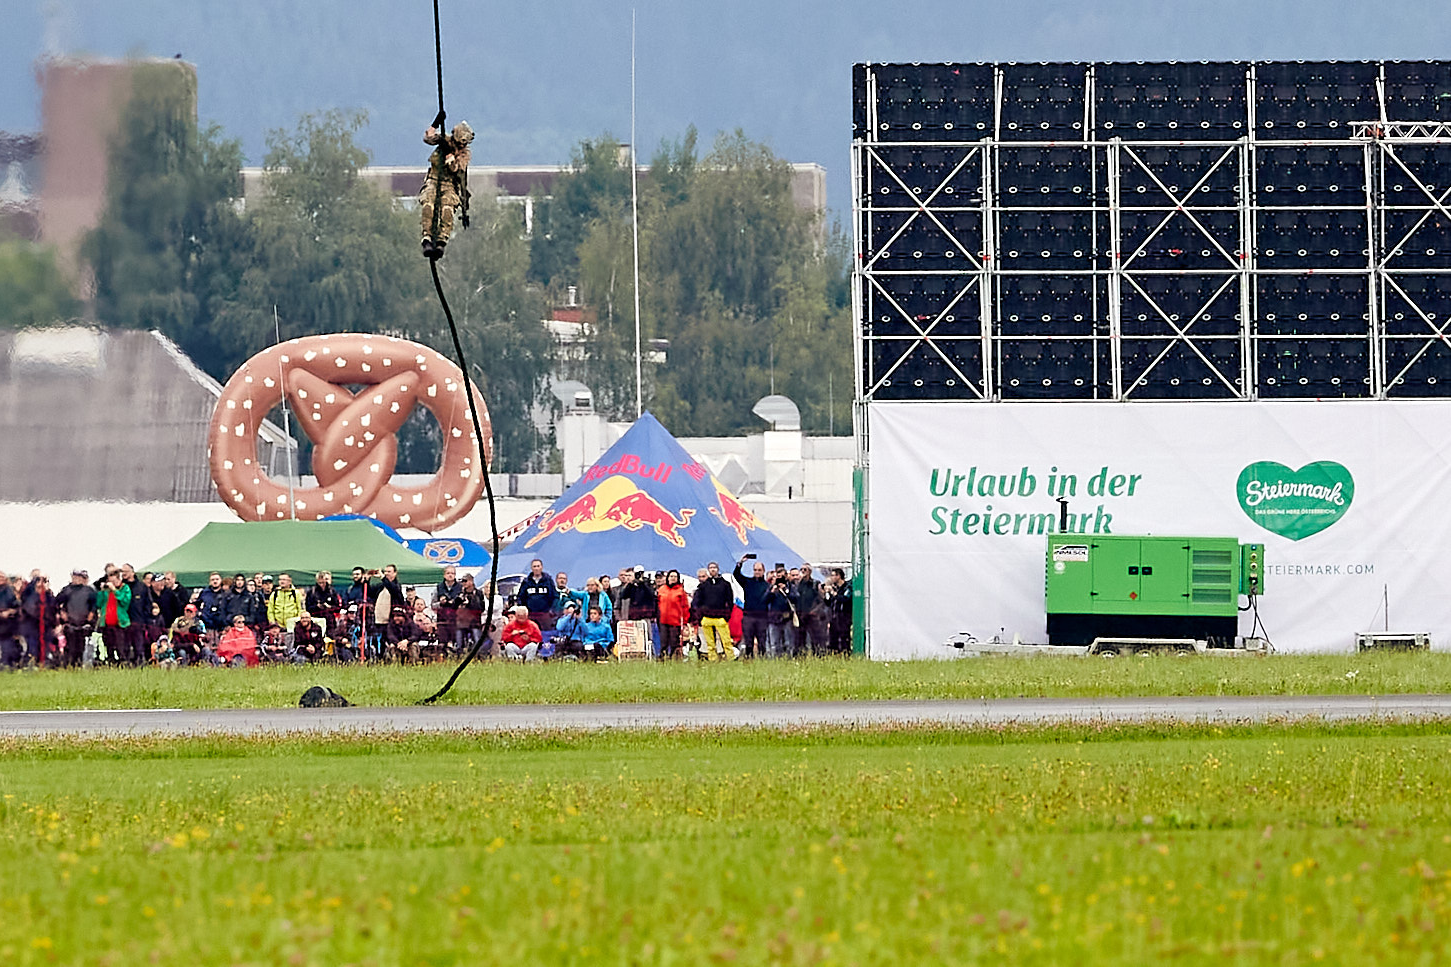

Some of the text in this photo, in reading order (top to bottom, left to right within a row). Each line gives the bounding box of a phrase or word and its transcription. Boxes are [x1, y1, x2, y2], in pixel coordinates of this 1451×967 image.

[929, 466, 1142, 497] Urlaub in der
[1245, 479, 1345, 506] Steiermark
[1267, 564, 1375, 575] TEIERMARK.COM
